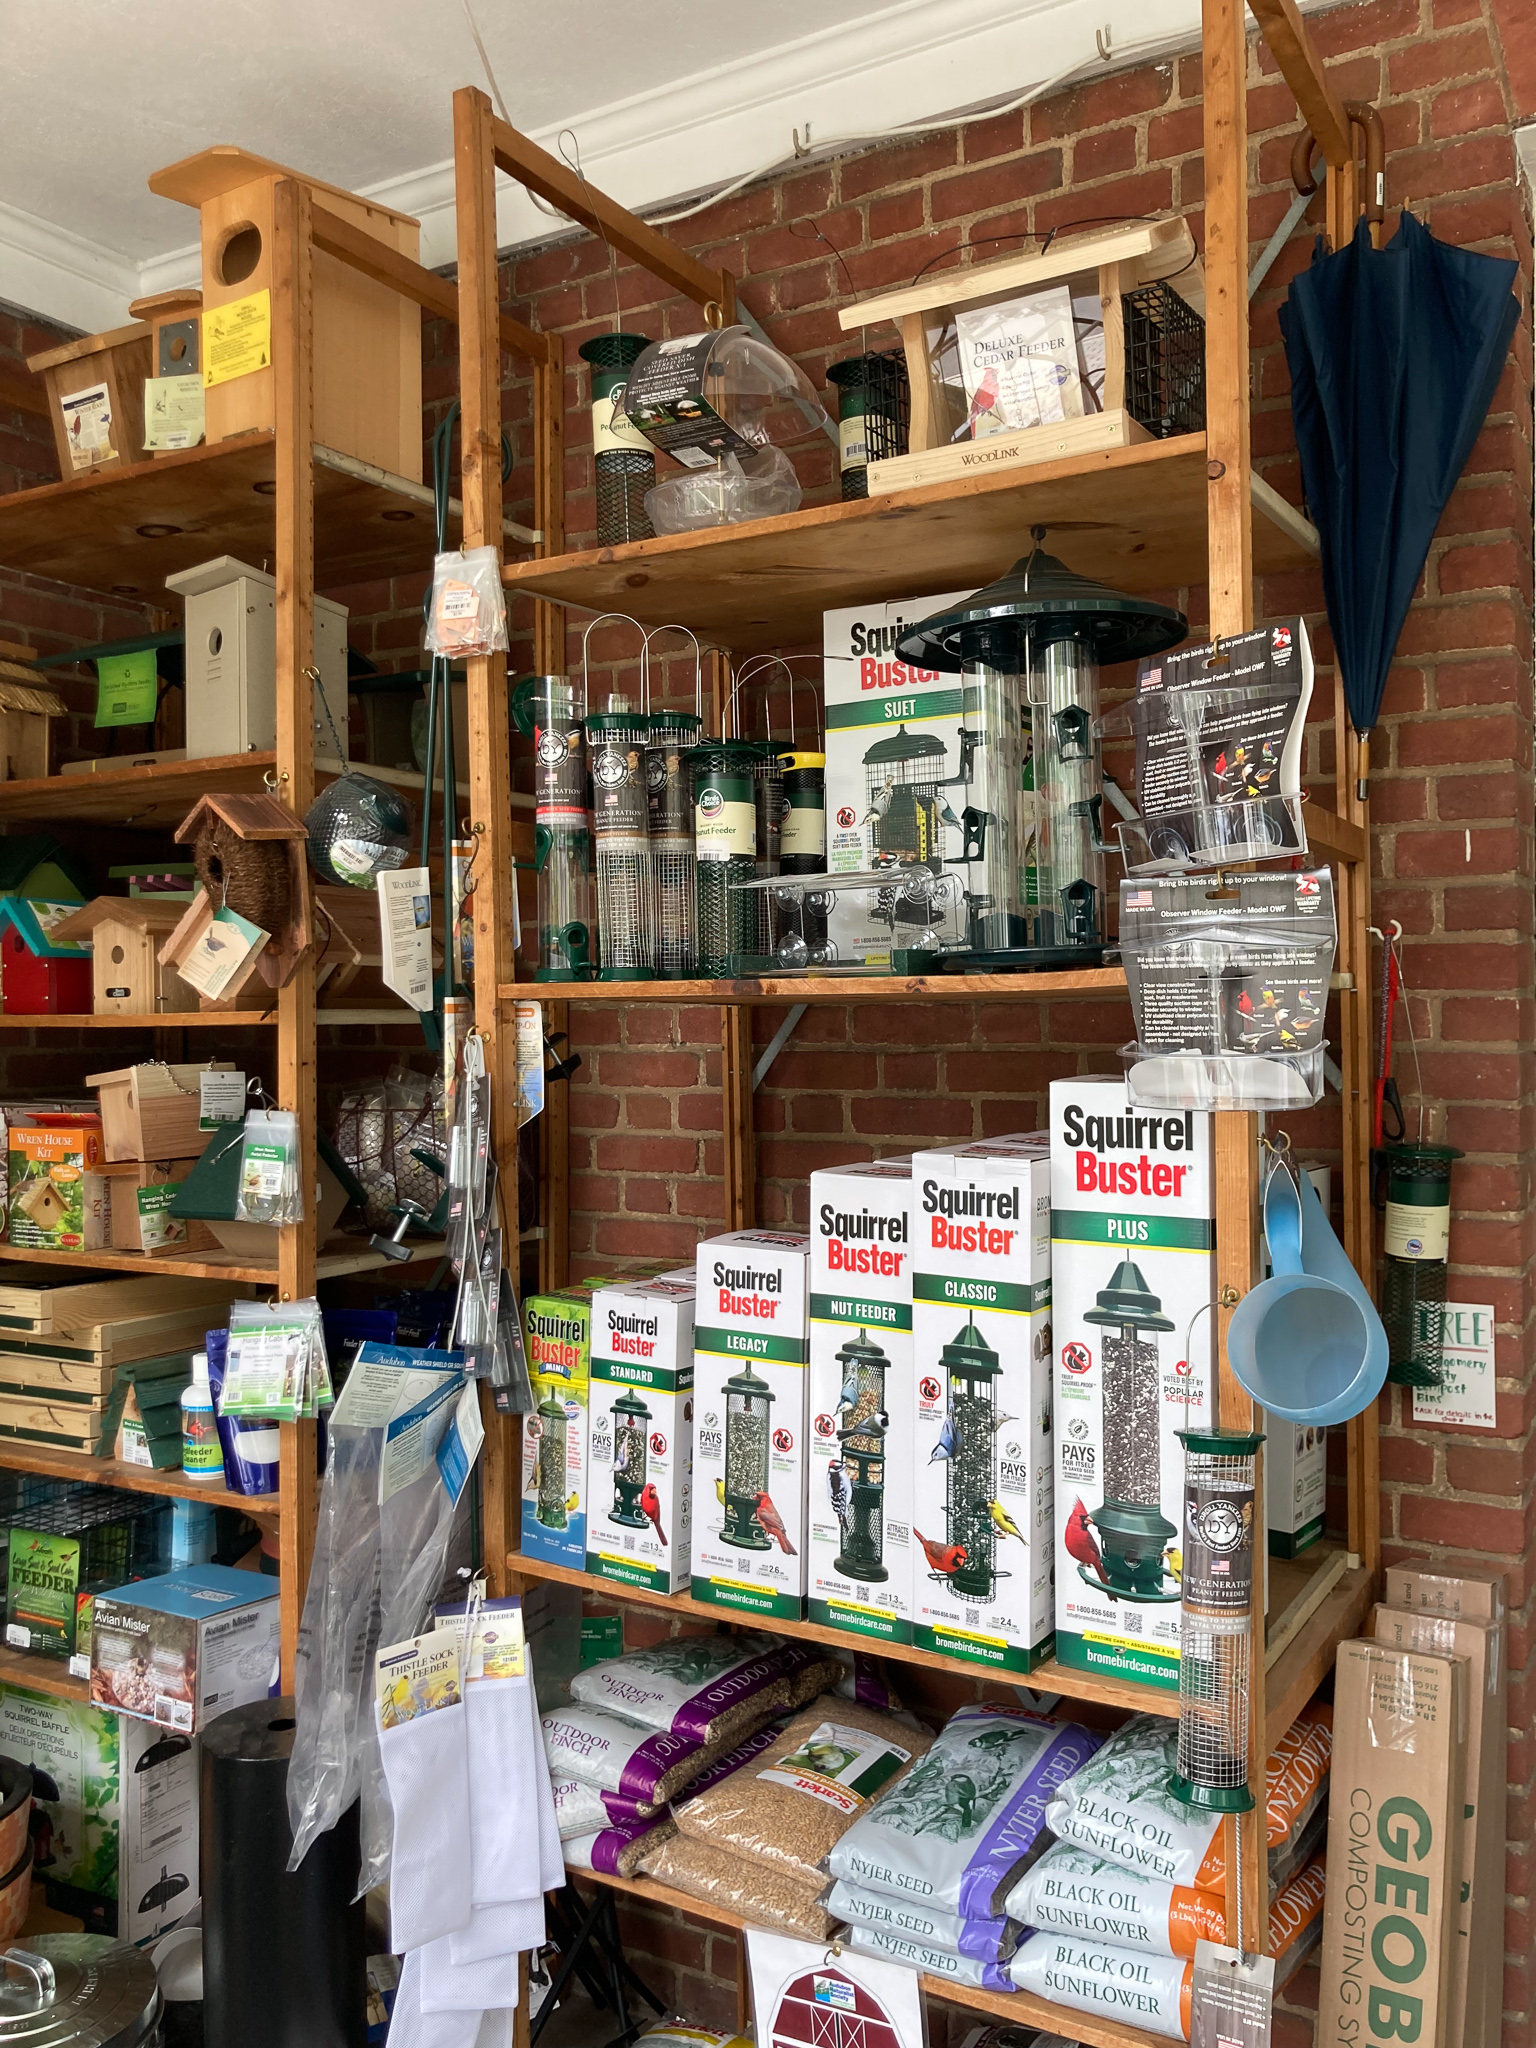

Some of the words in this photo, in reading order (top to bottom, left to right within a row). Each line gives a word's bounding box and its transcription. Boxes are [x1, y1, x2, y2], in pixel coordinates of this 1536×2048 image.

[973, 350, 1014, 368] CEDAR
[1020, 337, 1065, 358] FEEDER
[974, 334, 1024, 354] DELUXE
[1166, 655, 1182, 664] Bring
[1190, 649, 1205, 657] birds
[1218, 643, 1226, 651] up
[1231, 639, 1245, 648] your
[1244, 631, 1267, 643] window!
[1190, 676, 1213, 687] Window
[1212, 672, 1231, 682] Feeder
[1234, 667, 1252, 677] Model
[1252, 661, 1266, 671] OWF
[884, 699, 916, 719] SUET
[711, 826, 736, 835] Feeder
[1159, 880, 1177, 888] Bring
[1177, 879, 1189, 887] the
[1189, 878, 1207, 886] birds
[1224, 877, 1234, 885] up
[1241, 875, 1258, 884] your
[1258, 874, 1287, 882] window!
[1160, 909, 1190, 918] Observer
[1190, 908, 1218, 917] Window
[1218, 907, 1243, 915] Feeder
[1247, 906, 1269, 914] Model
[1269, 904, 1287, 913] OWF
[17, 1133, 43, 1145] WREN
[44, 1134, 73, 1146] HOUSE
[1063, 1104, 1193, 1153] Squirrel
[36, 1147, 53, 1158] KIT
[1076, 1150, 1187, 1197] Buster
[93, 1199, 102, 1219] KIT
[141, 1195, 164, 1204] Hanging
[922, 1179, 1019, 1220] Squirrel
[102, 1206, 112, 1245] HOUSE
[820, 1204, 908, 1243] Squirrel
[931, 1215, 1014, 1255] Buster
[1107, 1218, 1149, 1241] PLUS
[828, 1239, 903, 1277] Buster
[713, 1261, 782, 1293] Squirrel
[944, 1280, 997, 1302] CLASSIC
[719, 1288, 778, 1319] Buster
[831, 1300, 853, 1316] NUT
[855, 1302, 896, 1322] FEEDER
[527, 1310, 585, 1342] Squirrel
[608, 1309, 658, 1337] Squirrel
[531, 1335, 581, 1368] Buster
[612, 1331, 655, 1357] Buster
[727, 1335, 768, 1353] LEGACY
[377, 1355, 406, 1367] Audubon
[412, 1359, 433, 1367] WEATHER
[545, 1363, 564, 1374] MINI
[610, 1365, 654, 1383] STANDARD
[1163, 1375, 1181, 1384] VOTED
[1196, 1379, 1204, 1387] BY
[1164, 1386, 1204, 1399] POPULAR
[1165, 1393, 1202, 1406] SCIENCE
[592, 1433, 612, 1447] PAYS
[700, 1430, 722, 1444] PAYS
[1061, 1443, 1096, 1463] PAYS
[1062, 1459, 1074, 1467] FOR
[1075, 1460, 1095, 1468] ITSELF
[1000, 1461, 1026, 1478] PAYS
[887, 1523, 910, 1536] ATTRACTS
[12, 1567, 75, 1595] FEEDER
[602, 1564, 652, 1585] bromebirdcare.com
[769, 1565, 780, 1574] 2.6
[1192, 1587, 1219, 1597] PEANUT
[1199, 1579, 1252, 1589] GENERATION
[715, 1588, 773, 1609] bromebirdcare.com
[888, 1594, 899, 1604] 1.3
[94, 1610, 121, 1626] Avian
[122, 1616, 150, 1633] Mister
[488, 1612, 515, 1621] FEEDER
[829, 1609, 893, 1633] bromebirdcare.com
[1000, 1616, 1012, 1626] 2.4
[1076, 1604, 1117, 1619] 1-800-856-5685
[204, 1622, 230, 1638] Avian
[231, 1611, 259, 1628] Mister
[936, 1635, 1004, 1661] bromebirdcare.com
[1090, 1633, 1112, 1643] LIFETIME
[1113, 1637, 1126, 1645] CARE
[1131, 1642, 1160, 1653] ASSISTANCE
[1166, 1648, 1175, 1656] VIE
[389, 1657, 429, 1678] THISTLE
[429, 1647, 454, 1662] SOCK
[411, 1661, 449, 1680] FEEDER
[1087, 1648, 1179, 1680] bromebirdcare.com
[601, 1674, 664, 1702] OUTDOOR
[605, 1687, 647, 1705] FINCH
[4, 1710, 41, 1727] SQUIRREL
[41, 1720, 70, 1735] BAFFLE
[19, 1704, 54, 1719] TWO-WAY
[979, 1704, 1061, 1724] Scarlett
[9, 1724, 26, 1736] DEUX
[26, 1729, 65, 1746] DIRECTIONS
[542, 1718, 611, 1751] OUTDOOR
[550, 1733, 594, 1757] FINCH
[728, 1729, 780, 1767] FINCH
[794, 1778, 853, 1810] Scarlett
[988, 1793, 1048, 1860] NYJER
[1036, 1745, 1081, 1794] SEED
[1075, 1796, 1139, 1834] BLACK
[1142, 1824, 1175, 1850] OIL
[1062, 1818, 1176, 1880] SUNFLOWER
[850, 1857, 893, 1884] NYJER
[896, 1874, 934, 1896] SEED
[1044, 1879, 1105, 1906] BLACK
[1109, 1891, 1141, 1913] OIL
[1339, 1788, 1372, 2006] COMPOSTING
[848, 1899, 893, 1923] NYJER
[896, 1914, 934, 1936] SEED
[1036, 1904, 1151, 1942] SUNFLOWER
[872, 1932, 917, 1959] NYJER
[920, 1950, 958, 1972] SEED
[1055, 1945, 1116, 1976] BLACK
[1120, 1962, 1152, 1985] OIL
[830, 1981, 852, 1991] Audubon
[830, 1991, 849, 2002] Society
[1045, 1971, 1161, 2015] SUNFLOWER
[664, 2021, 731, 2037] Scarlett
